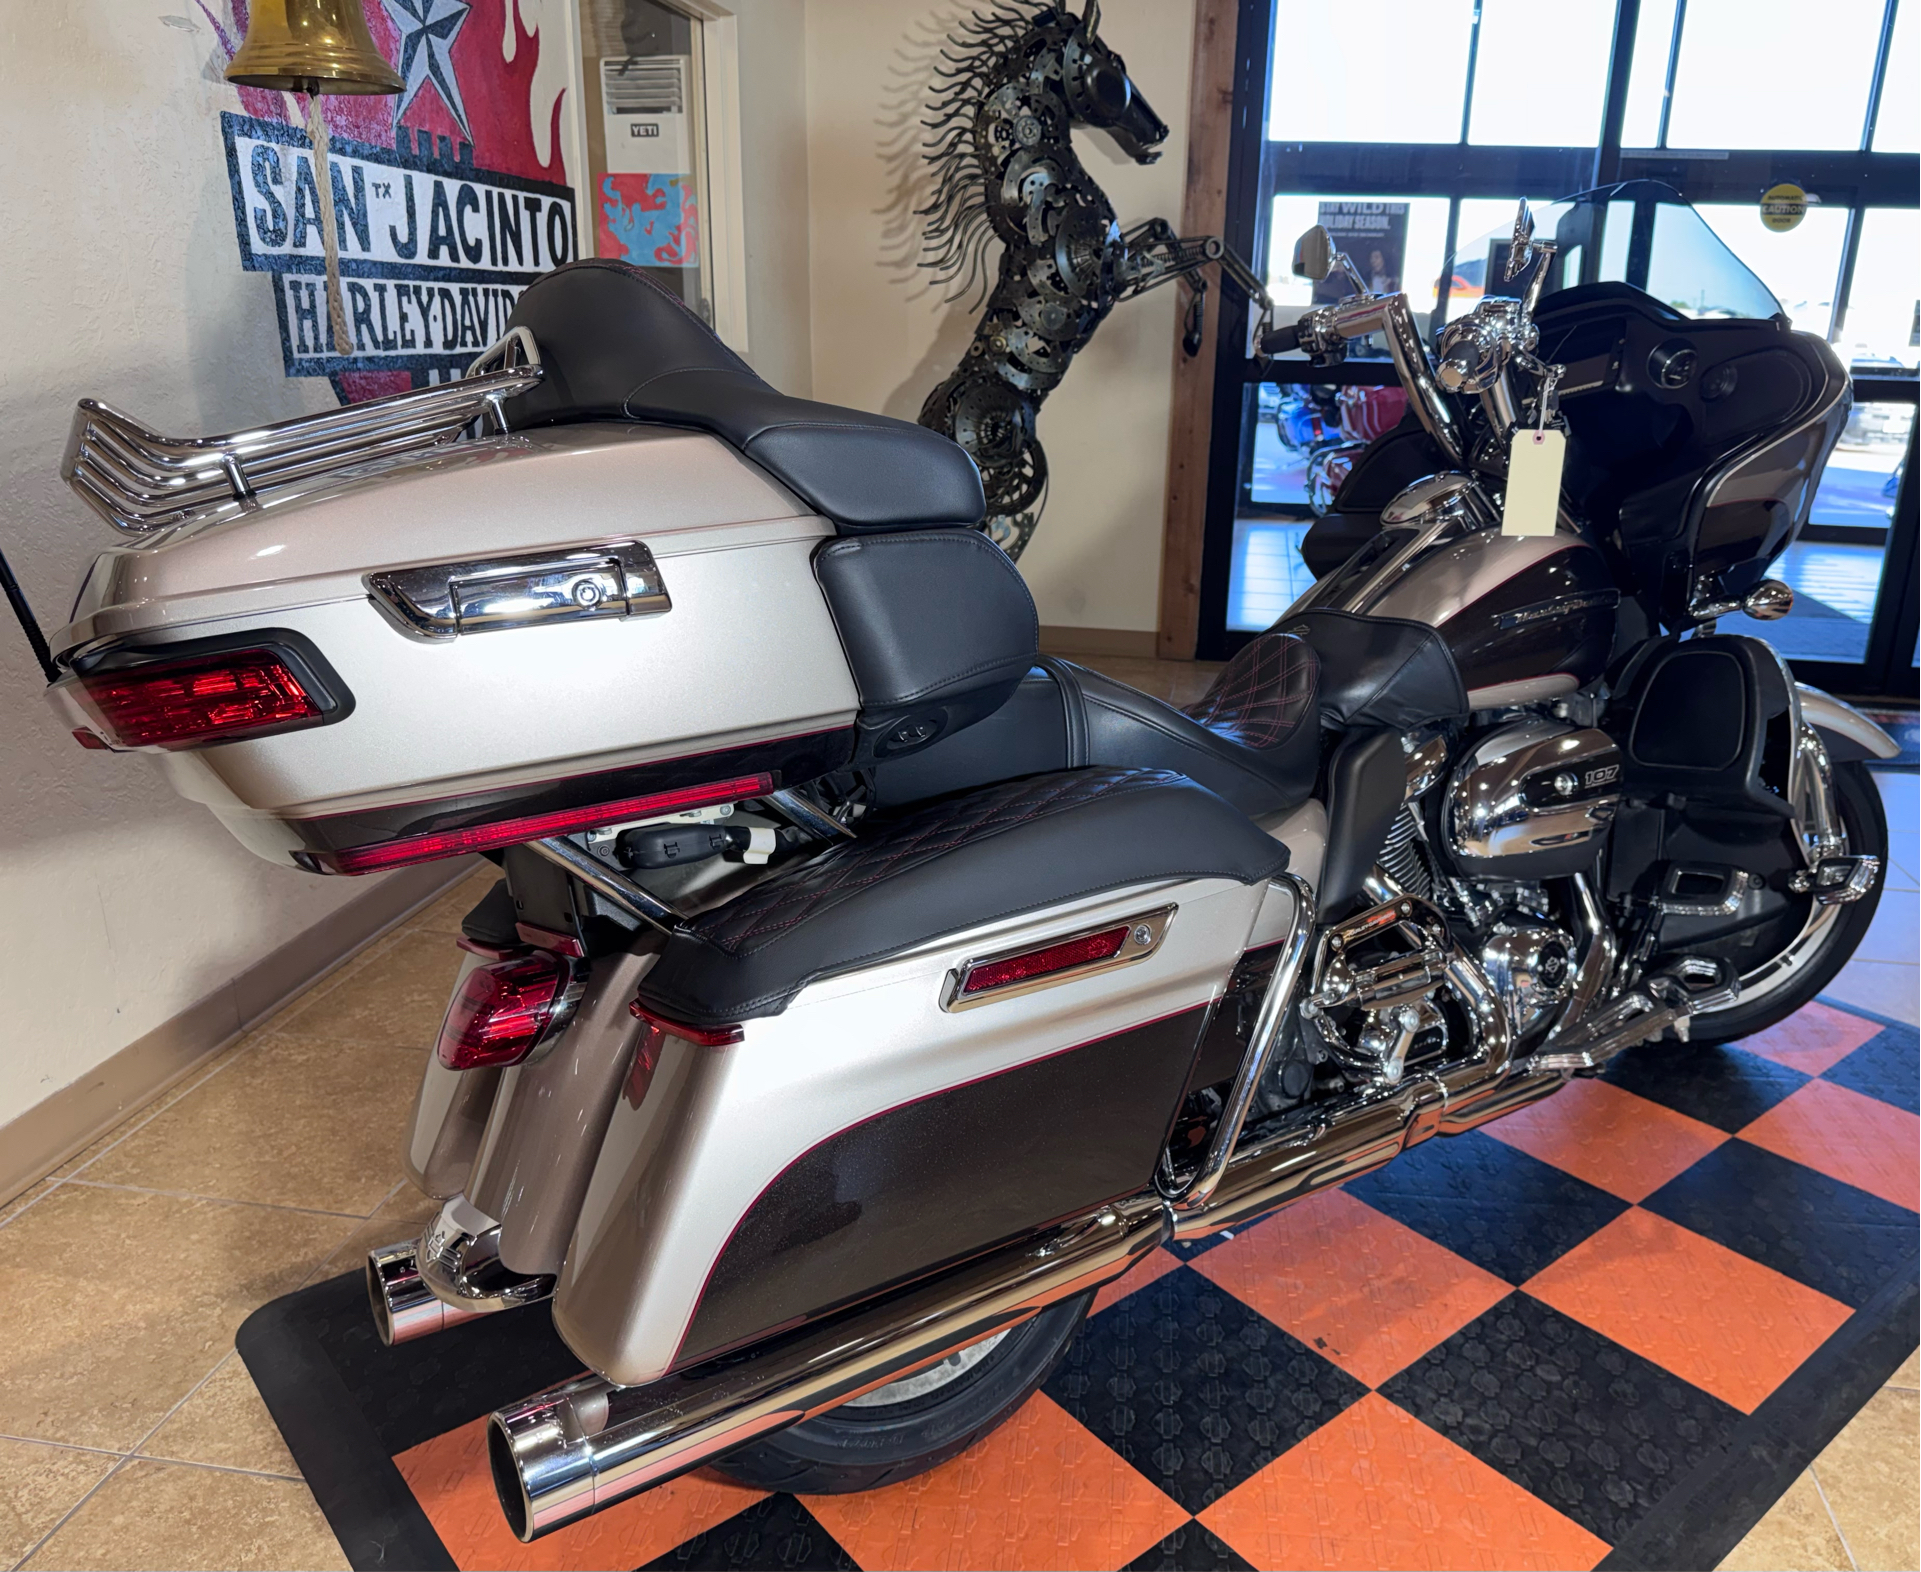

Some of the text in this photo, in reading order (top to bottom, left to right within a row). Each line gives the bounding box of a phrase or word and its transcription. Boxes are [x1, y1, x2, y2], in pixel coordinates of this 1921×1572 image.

[632, 125, 657, 136] YETI
[251, 144, 569, 268] SAN TX JACINTO
[1341, 202, 1384, 214] WILD
[1762, 205, 1805, 214] CAUTION
[1585, 764, 1620, 786] 107
